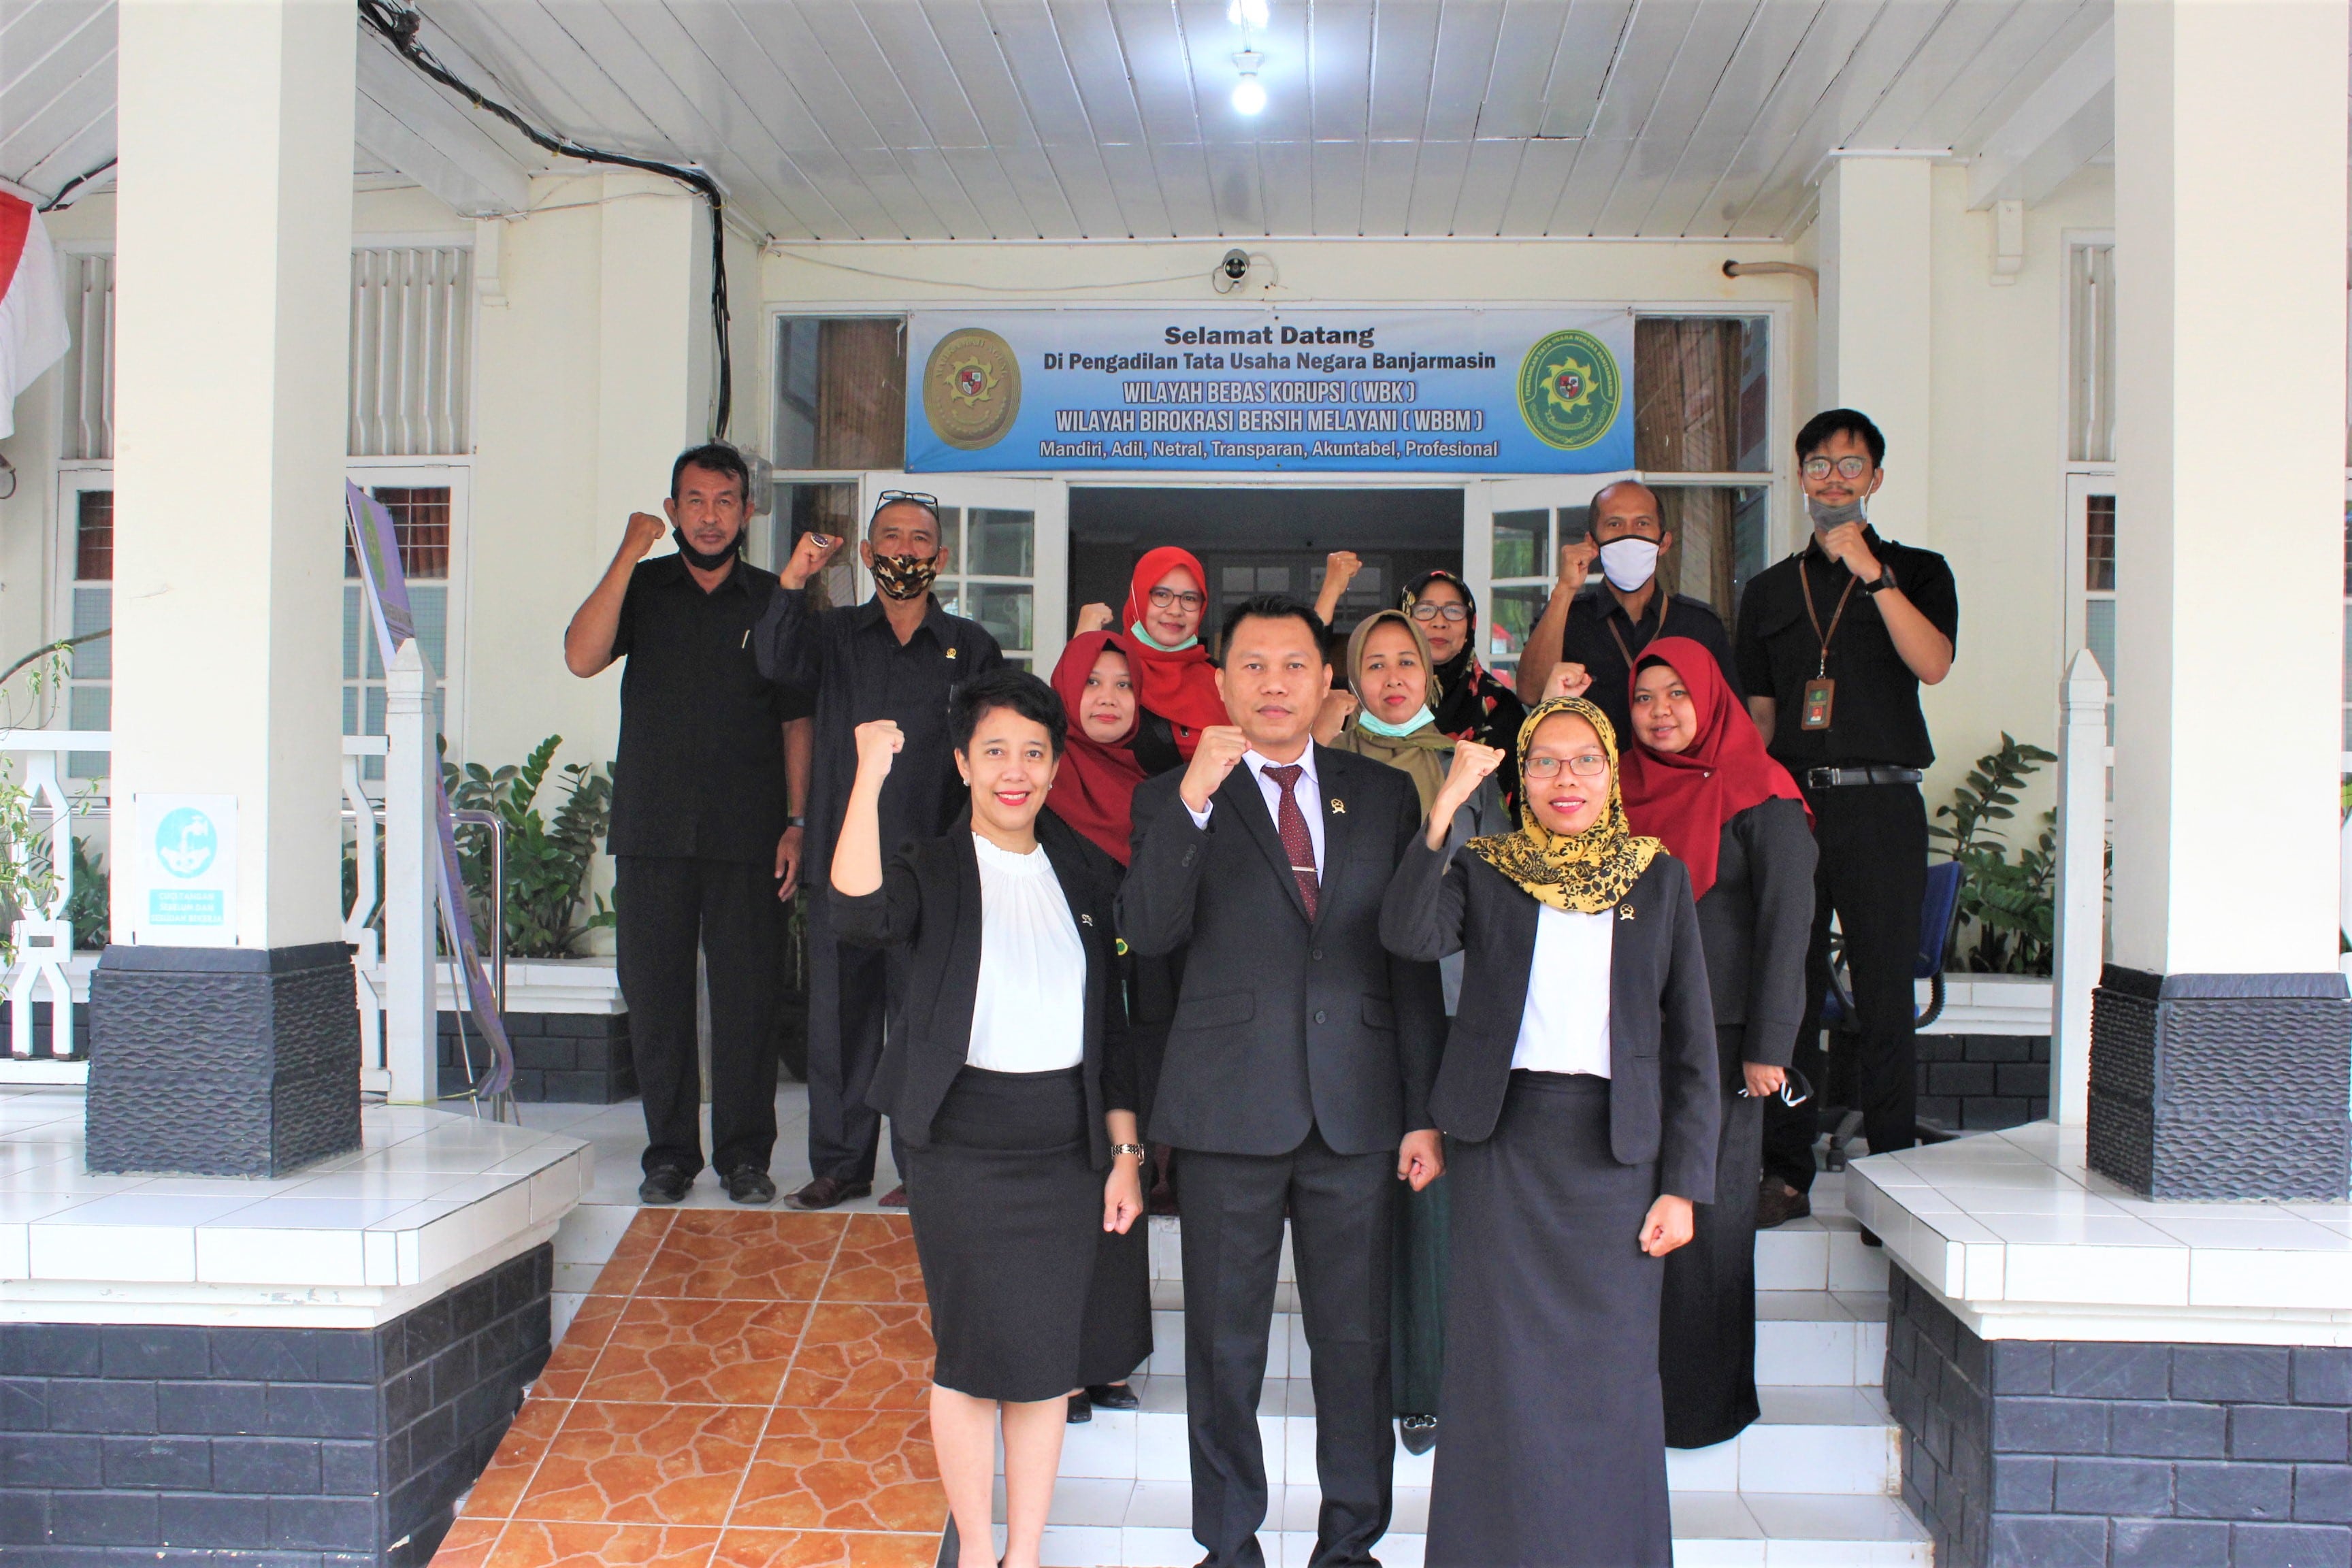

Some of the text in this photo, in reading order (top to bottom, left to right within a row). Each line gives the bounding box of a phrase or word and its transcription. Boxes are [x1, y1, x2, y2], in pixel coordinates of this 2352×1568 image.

[1164, 326, 1375, 348] Selamat Datang
[1044, 352, 1496, 374] Di Pengadilan Tata Usaha Negara Banjarmasin
[1123, 381, 1203, 404] WILAYAH
[1207, 381, 1266, 404] BEBAS
[1270, 381, 1346, 403] KORUPSI
[1056, 410, 1135, 432] WILAYAH
[1139, 410, 1235, 432] BIROKRASI
[1239, 410, 1303, 432] BERSIH
[1307, 409, 1397, 431] MELAYANI
[1039, 440, 1499, 459] Mandiri, Adil, Netral, Transparan, Akuntabel, Profesional
